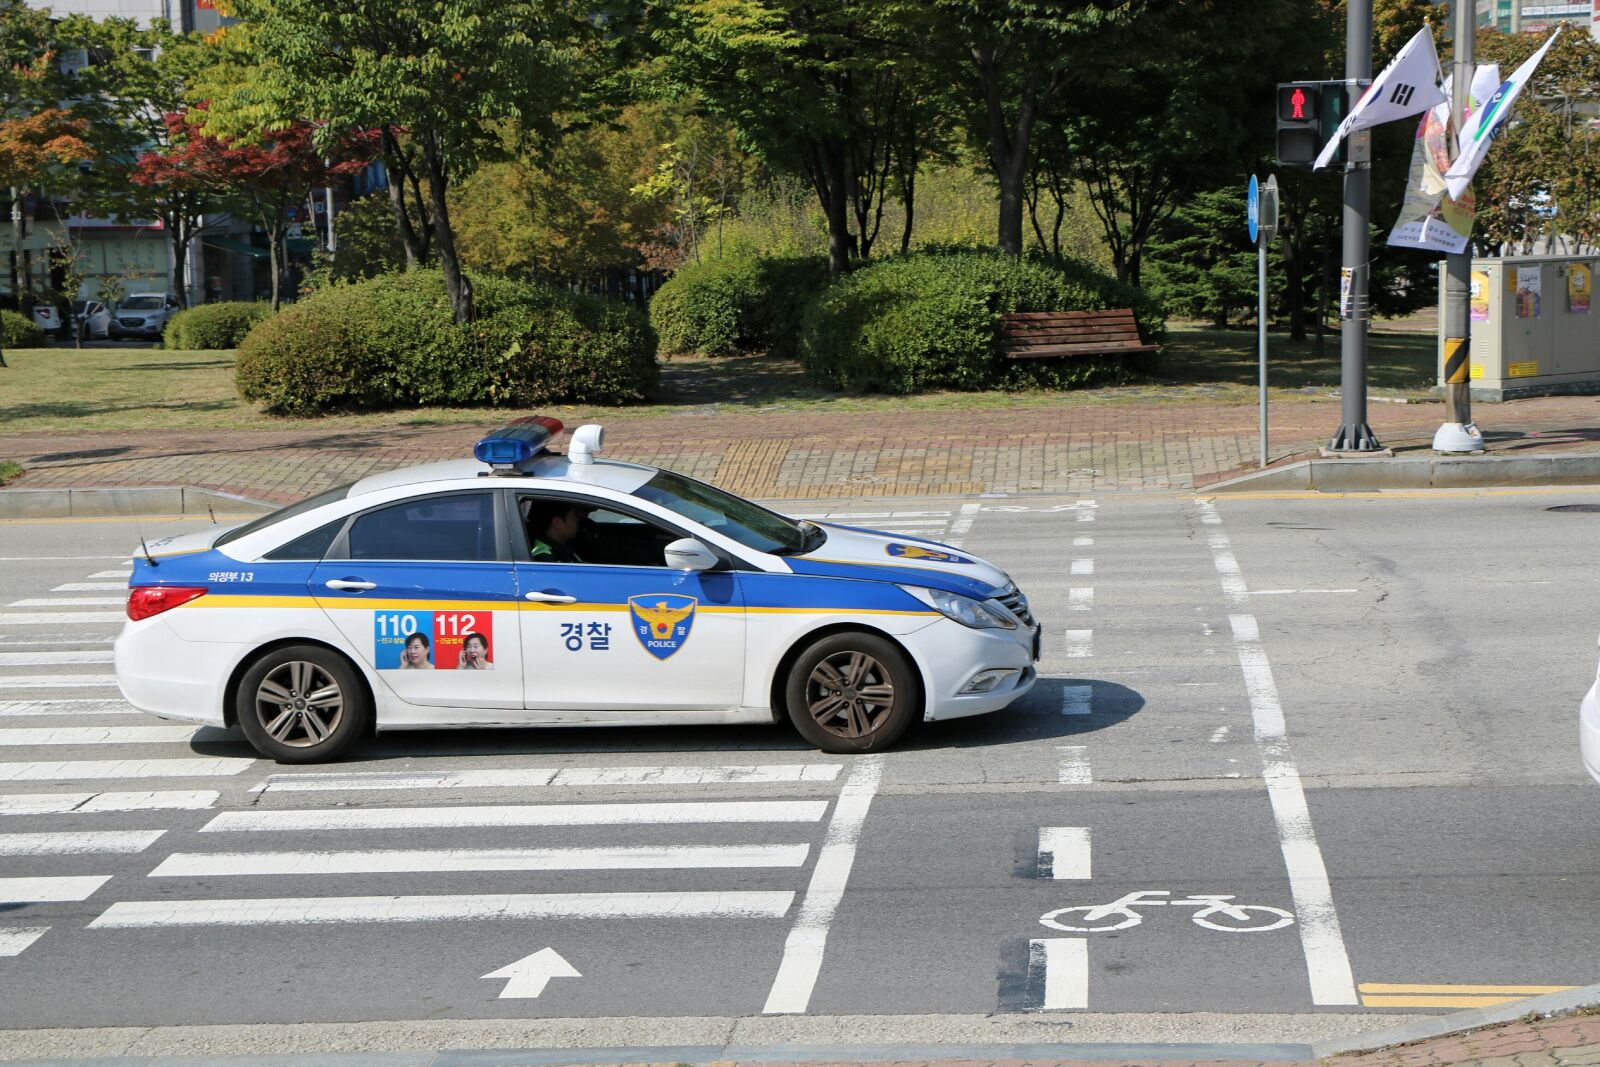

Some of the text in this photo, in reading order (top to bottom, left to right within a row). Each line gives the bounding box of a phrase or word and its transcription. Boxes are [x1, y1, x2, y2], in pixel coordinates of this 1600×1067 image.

[208, 571, 254, 583] 의정부 13
[377, 614, 418, 636] 110
[435, 614, 477, 636] 112
[560, 621, 612, 652] 경찰
[647, 640, 678, 649] POLICE
